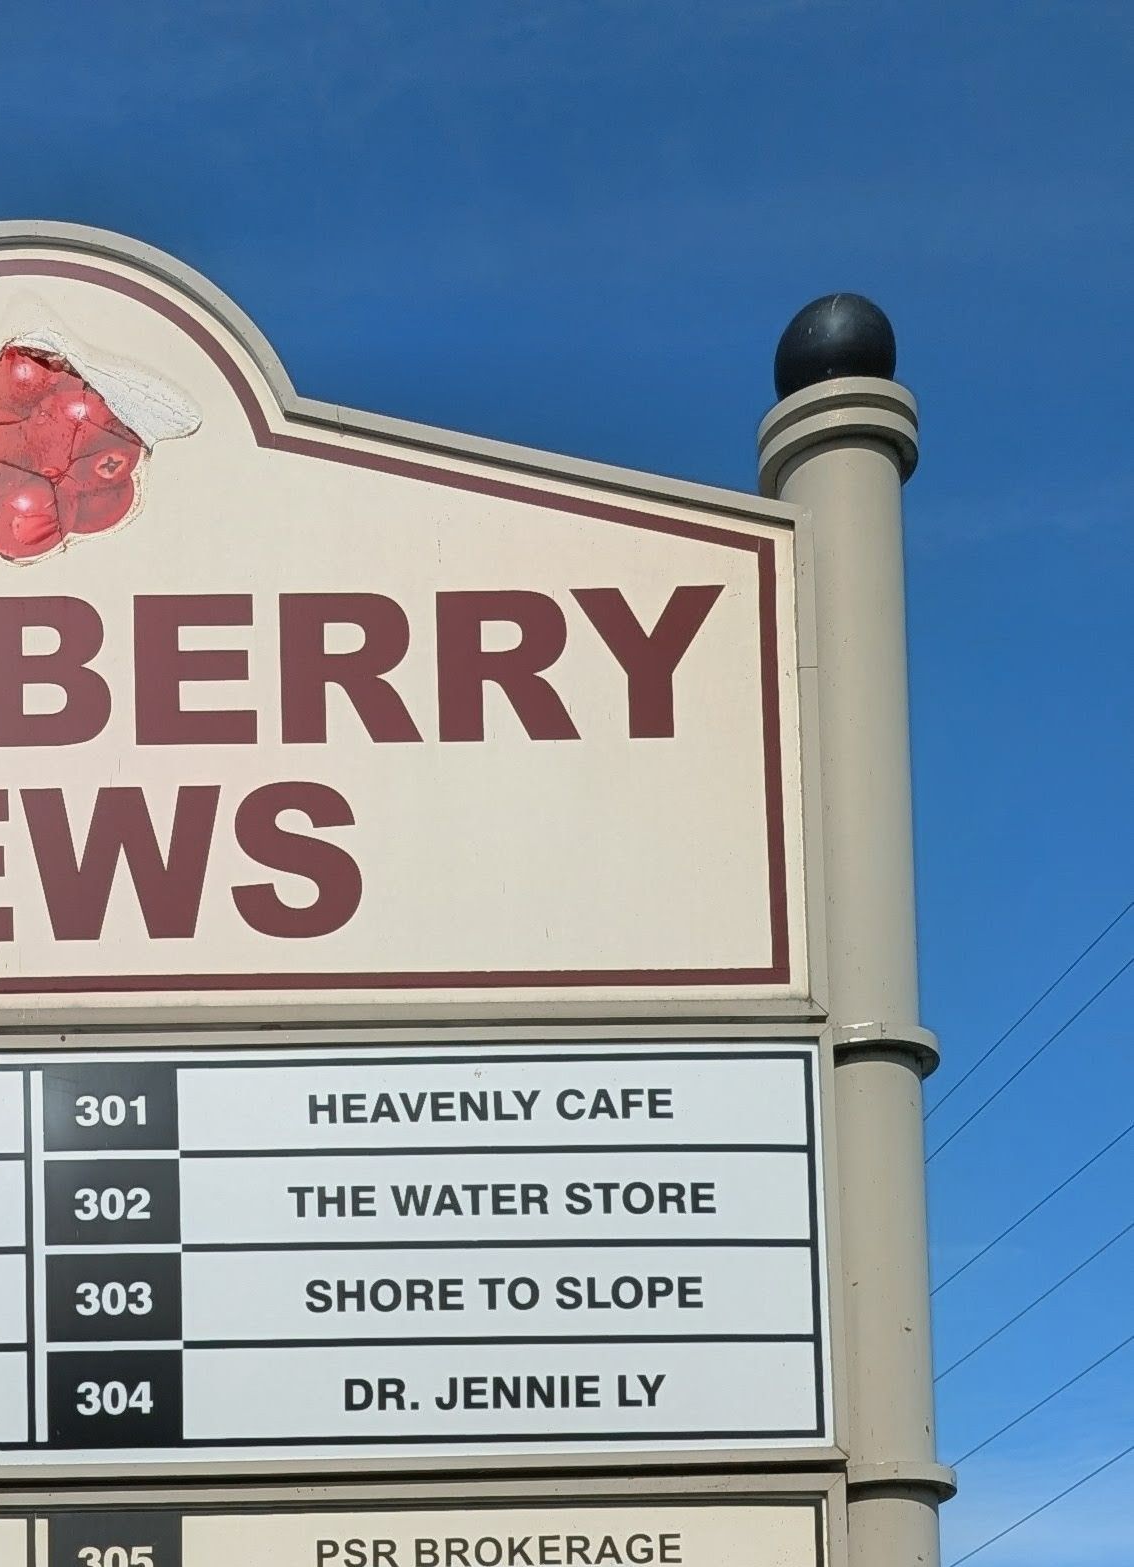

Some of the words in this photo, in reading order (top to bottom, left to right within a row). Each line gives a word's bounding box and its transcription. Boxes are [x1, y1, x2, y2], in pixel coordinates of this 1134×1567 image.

[76, 1096, 146, 1126] 301
[309, 1090, 540, 1124] HEAVENLY
[556, 1089, 673, 1120] CAFE
[75, 1188, 150, 1220] 302
[288, 1186, 376, 1217] THE
[391, 1184, 548, 1216] WATER
[566, 1182, 716, 1215] STORE
[76, 1282, 152, 1315] 303
[306, 1279, 464, 1313] SHORE
[479, 1277, 539, 1310] TO
[556, 1276, 703, 1309] SLOPE
[77, 1381, 153, 1415] 304
[345, 1378, 419, 1411] DR.
[435, 1376, 600, 1410] JENNIE
[618, 1375, 666, 1407] LY
[415, 1534, 682, 1567] BROKERAGE
